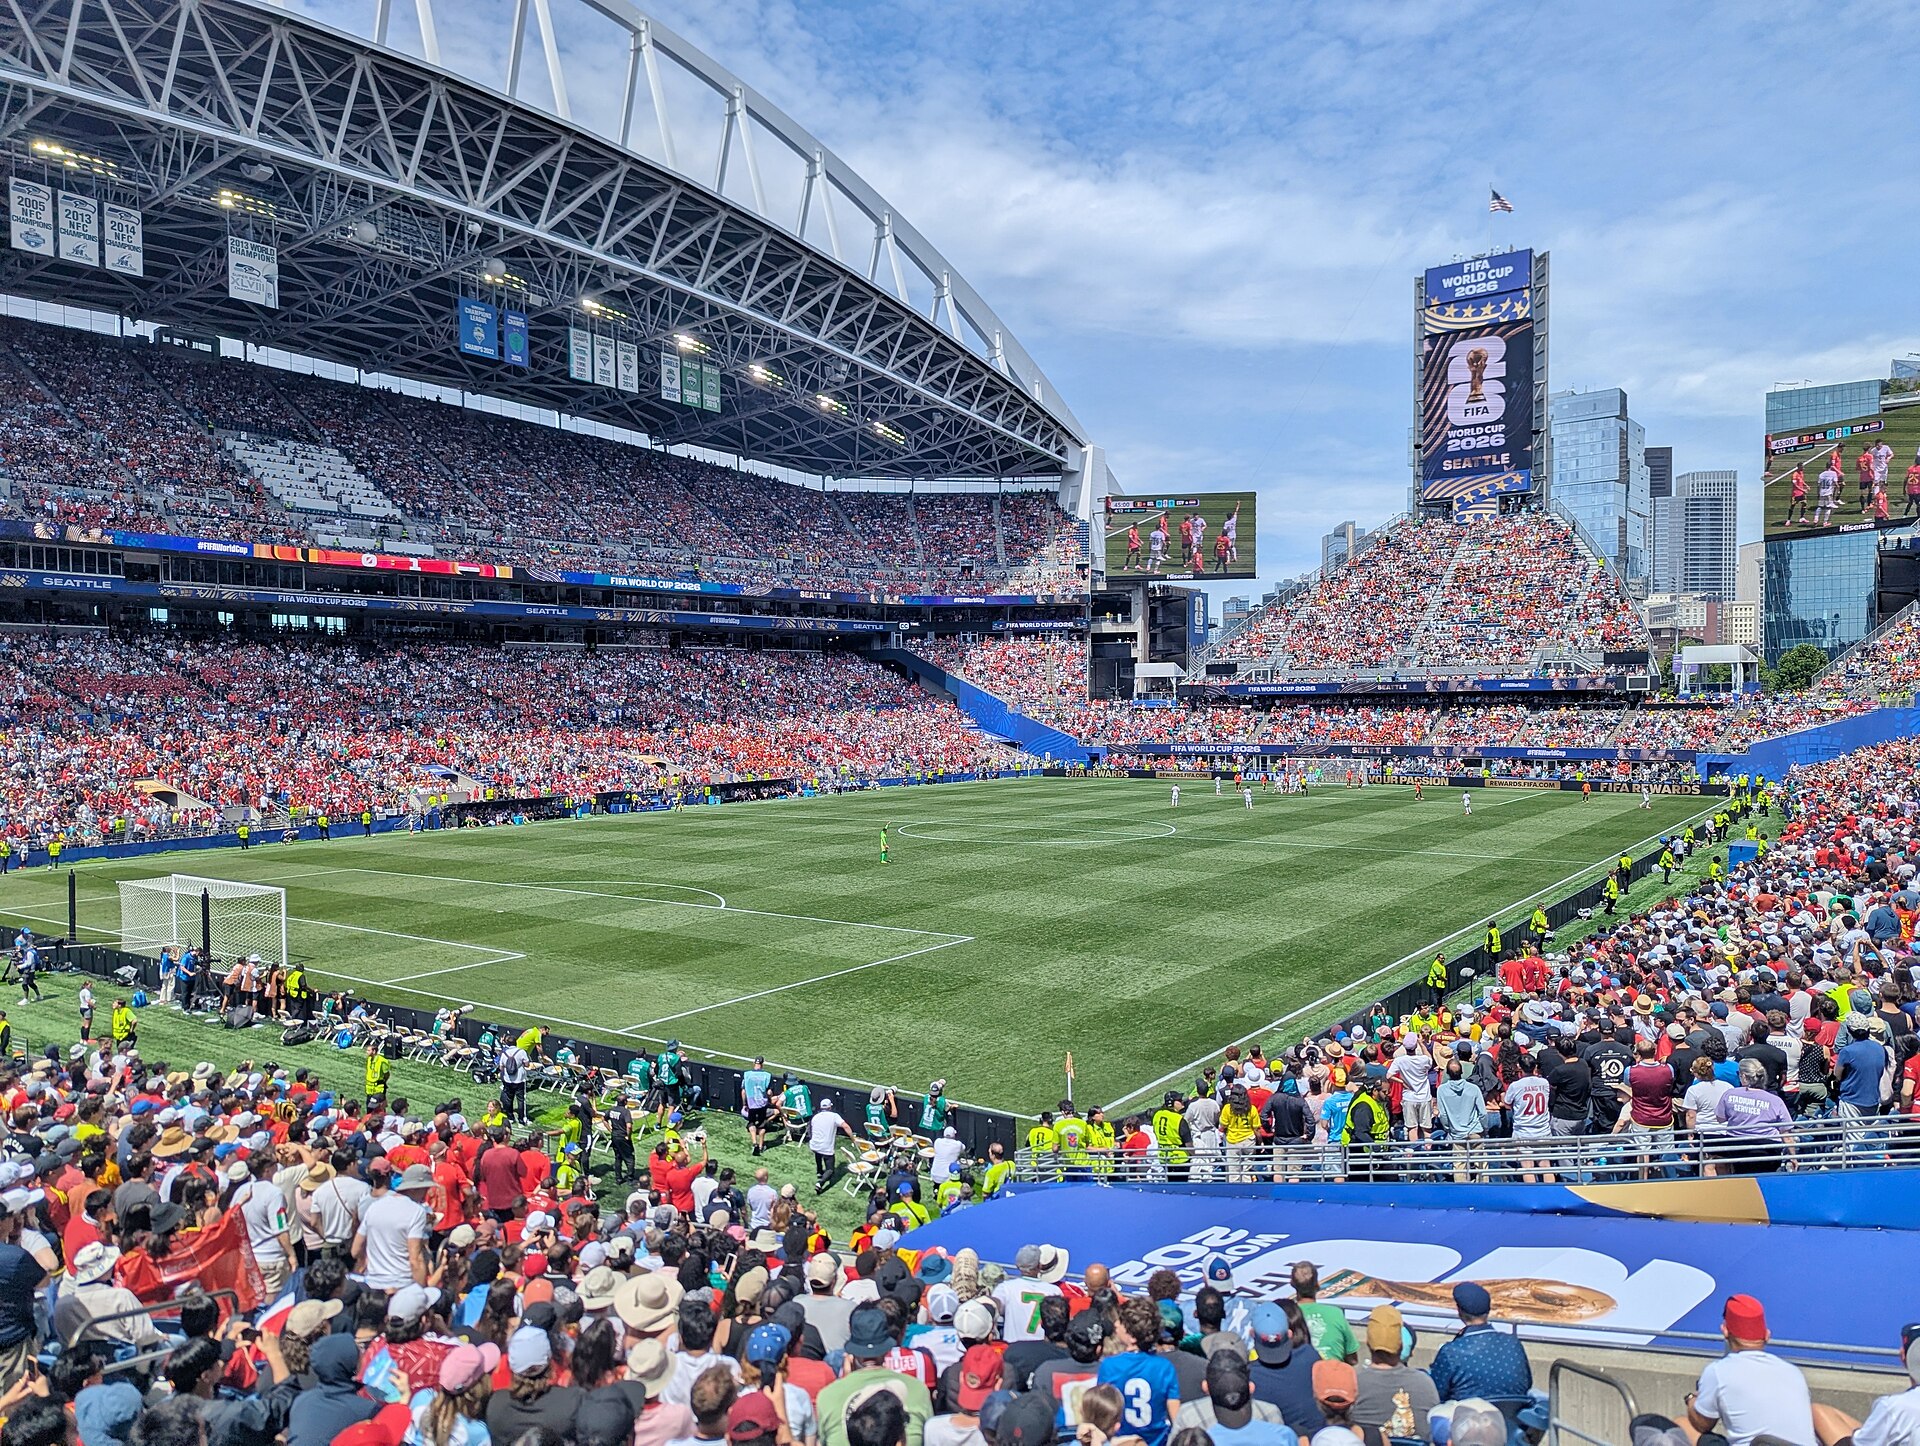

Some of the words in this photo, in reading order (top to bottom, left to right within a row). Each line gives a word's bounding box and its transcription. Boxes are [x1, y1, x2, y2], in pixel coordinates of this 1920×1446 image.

[17, 195, 46, 212] 2005
[21, 208, 42, 220] NFC
[64, 209, 92, 225] 2013
[11, 215, 53, 231] CHAMPIONS
[69, 220, 89, 233] NFC
[110, 220, 137, 236] 2014
[60, 227, 98, 243] CHAMPIONS
[114, 232, 133, 244] NFC
[105, 238, 142, 254] CHAMPIONS
[230, 238, 249, 250] 2013
[250, 242, 275, 257] WORLD
[230, 245, 276, 264] CHAMPIONS
[1463, 259, 1491, 273] FIFA
[1442, 271, 1487, 289] WORLD
[1487, 265, 1514, 280] CUP
[1454, 280, 1499, 298] 2026
[1463, 406, 1490, 417] FIFA
[1447, 426, 1484, 438] WORLD
[1484, 424, 1506, 434] CUP
[1447, 433, 1506, 452] 2026
[1774, 438, 1794, 448] 45:00
[1442, 452, 1510, 471] SEATTLE
[1839, 521, 1876, 533] Hisense
[197, 541, 249, 555] #FIFAWorldCup
[361, 552, 378, 568] 0
[409, 557, 422, 571] 1
[42, 576, 112, 589] SEATTLE
[610, 576, 629, 587] FIFA
[629, 577, 658, 588] WORLD
[658, 579, 675, 589] CUP
[674, 581, 701, 591] 2026
[278, 594, 295, 603] FIFA
[294, 595, 324, 605] WORLD
[325, 597, 340, 606] CUP
[341, 598, 368, 608] 2026
[799, 590, 831, 600] SEATTLE
[526, 607, 568, 616] SEATTLE
[1216, 745, 1232, 753] CUP
[1233, 745, 1262, 753] 2026
[1351, 746, 1392, 755] SEATTLE
[1086, 769, 1130, 778] REWARDS
[1368, 775, 1399, 785] YOUR
[1400, 776, 1450, 786] PASSION
[1489, 780, 1556, 789] REWARDS.FIFA.COM
[1600, 782, 1630, 792] FIFA
[1522, 1092, 1546, 1116] 20
[1728, 1095, 1756, 1107] STADIUM
[1756, 1099, 1770, 1110] FAN
[1733, 1104, 1761, 1115] SERVICES
[1021, 1291, 1047, 1334] 7
[1124, 1377, 1152, 1427] 3
